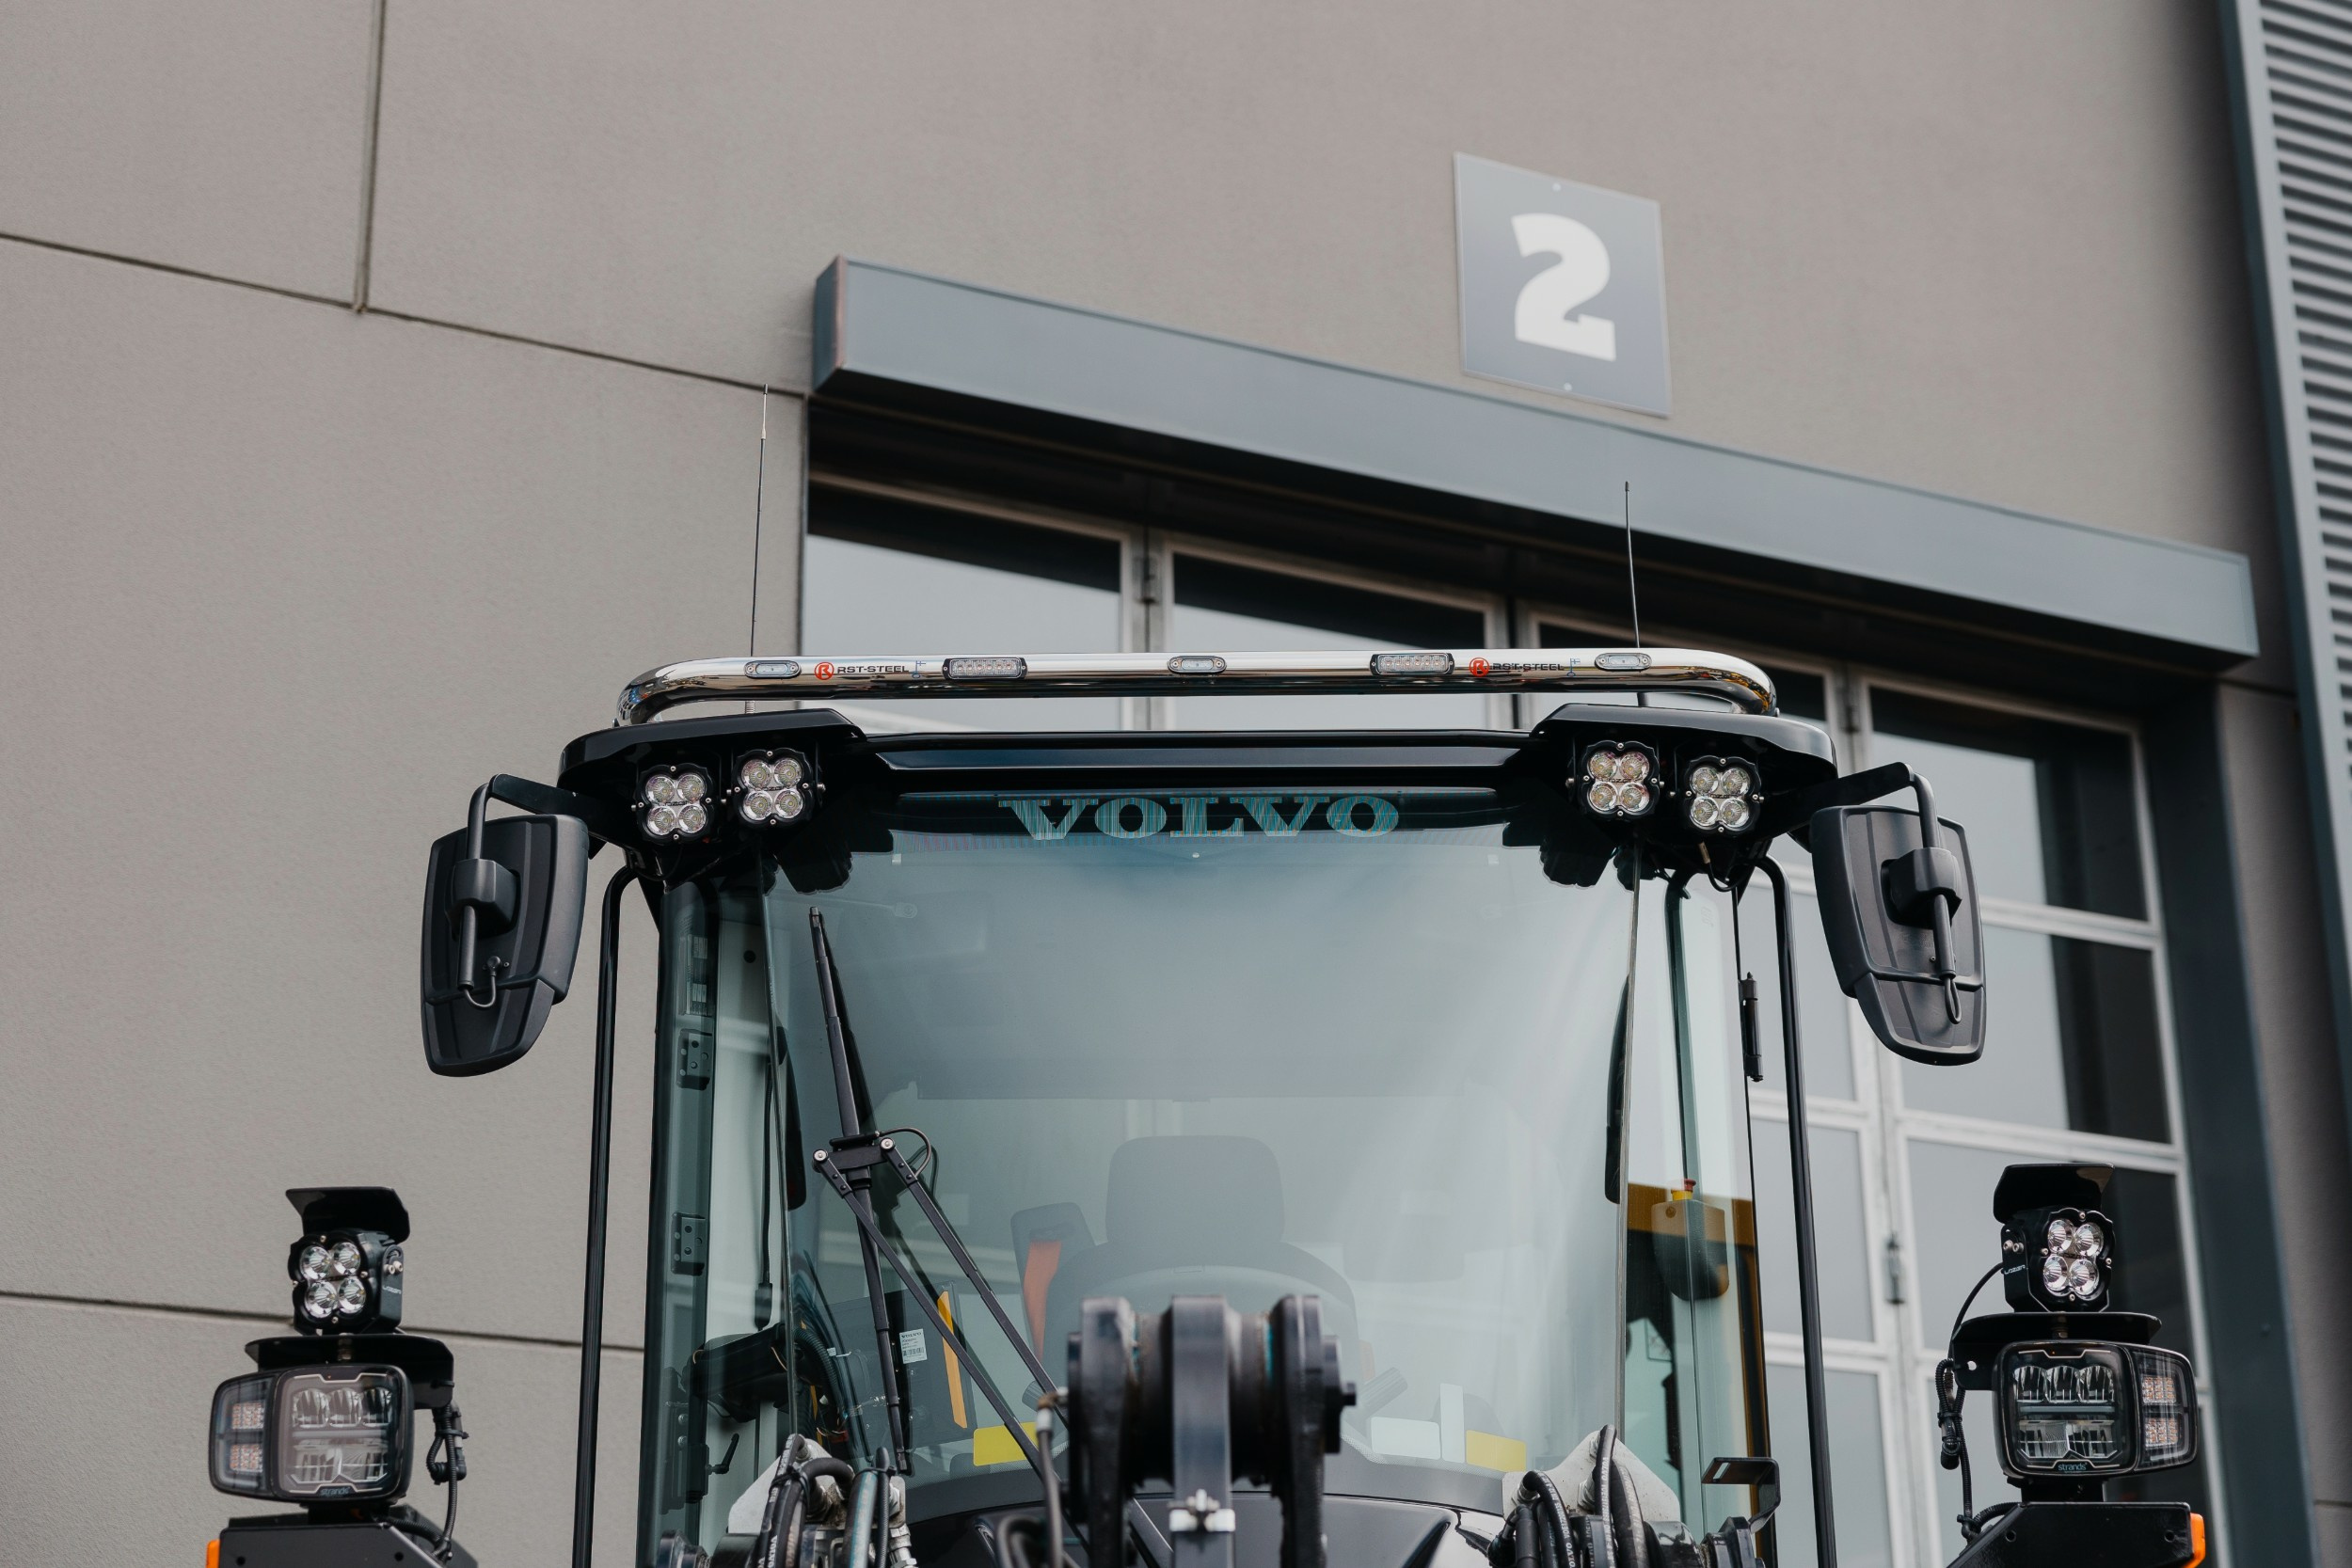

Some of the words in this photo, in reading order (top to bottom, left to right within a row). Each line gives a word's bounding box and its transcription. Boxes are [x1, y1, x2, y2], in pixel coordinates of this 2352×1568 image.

[1510, 212, 1616, 362] 2
[837, 665, 909, 673] RST-STEEL
[1493, 662, 1565, 671] RST-STEEL
[998, 796, 1399, 840] VOLVO
[2058, 1463, 2087, 1471] strands
[1565, 1543, 1576, 1568] OLVO
